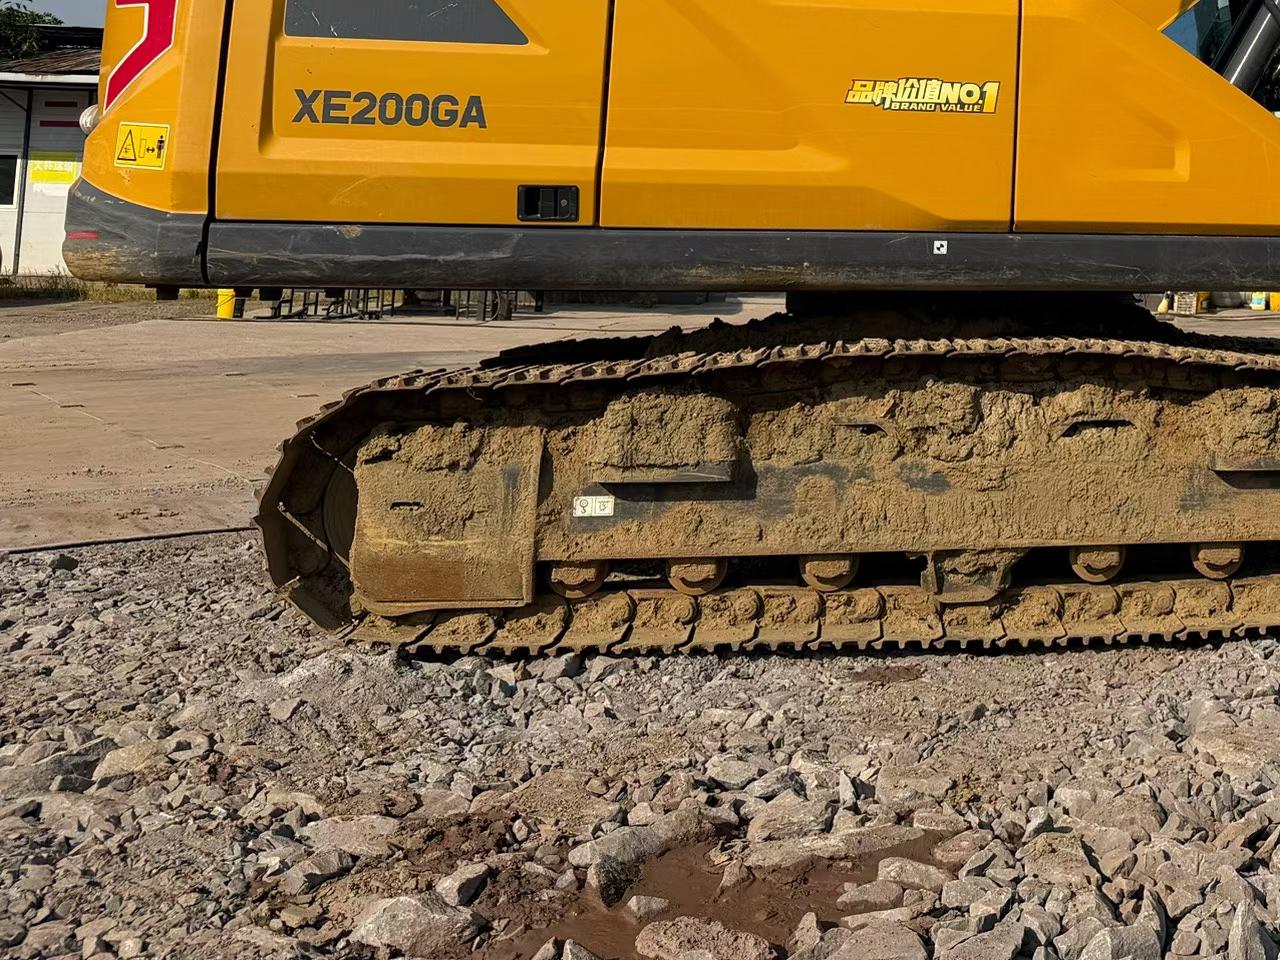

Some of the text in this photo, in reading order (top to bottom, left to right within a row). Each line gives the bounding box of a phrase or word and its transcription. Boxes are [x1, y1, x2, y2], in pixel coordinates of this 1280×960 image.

[292, 89, 487, 129] XE200GA
[891, 102, 981, 112] BRAND VALUE
